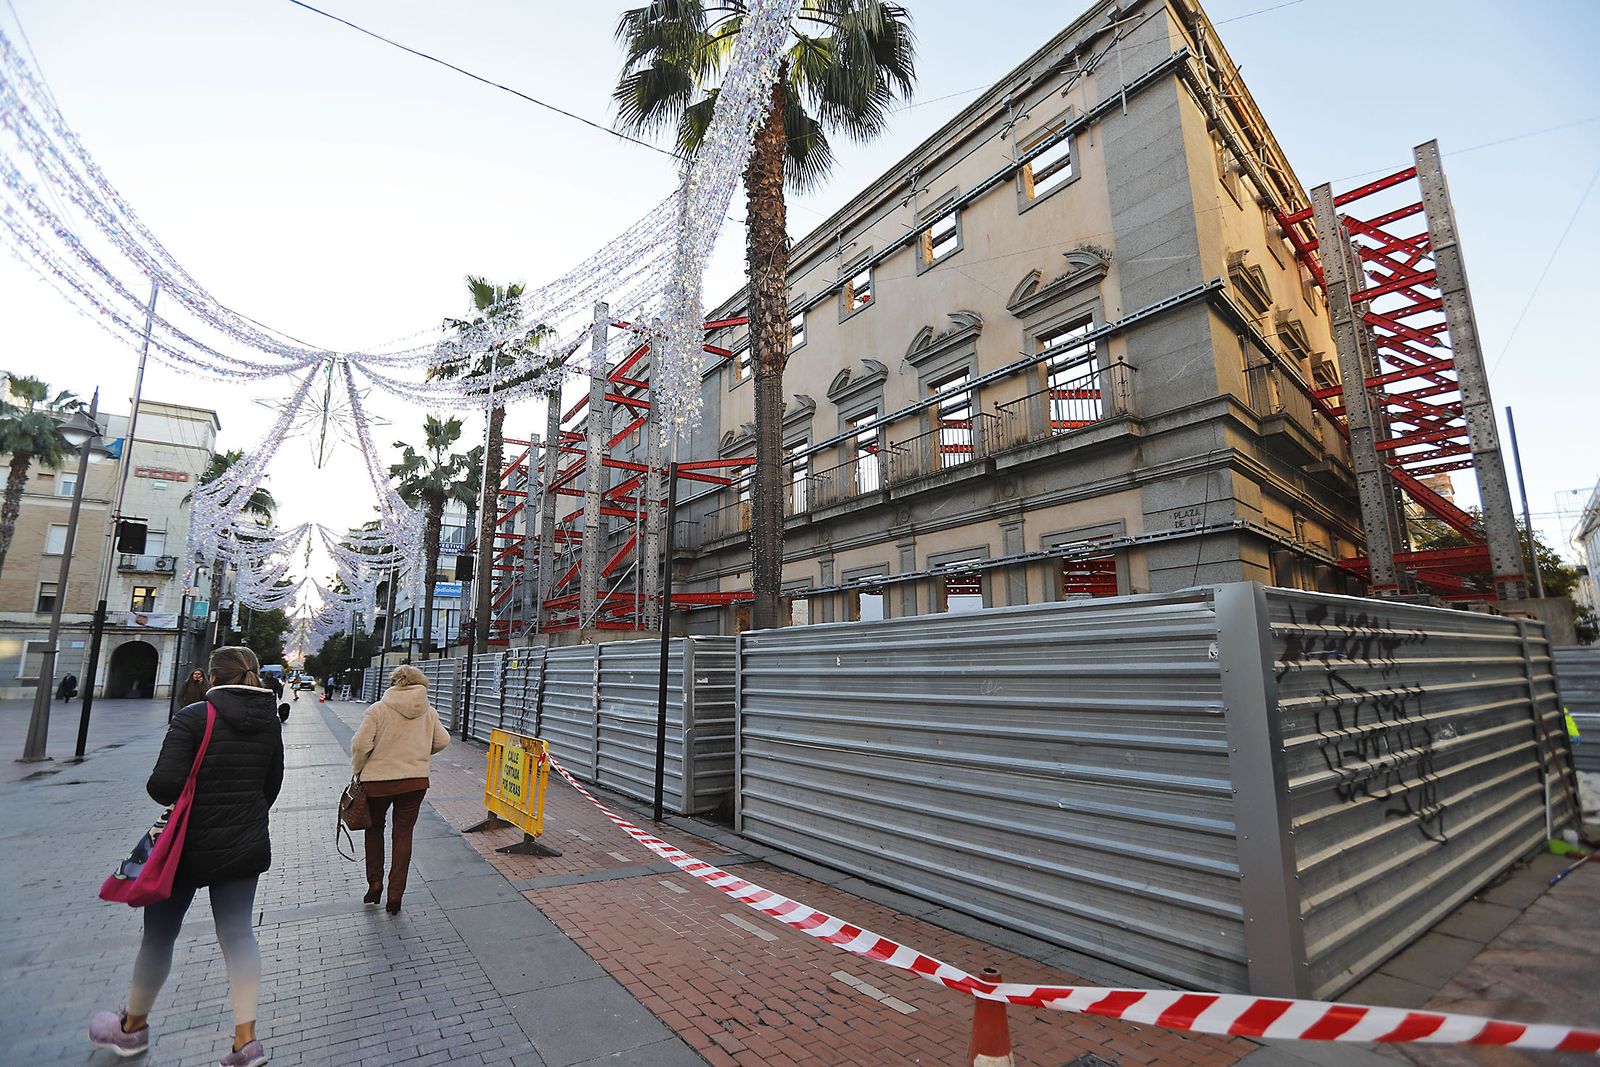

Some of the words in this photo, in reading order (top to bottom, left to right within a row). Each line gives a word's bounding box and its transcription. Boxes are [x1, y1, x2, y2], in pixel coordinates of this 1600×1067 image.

[1173, 509, 1201, 519] PLAZA
[1174, 520, 1186, 528] DE
[1190, 518, 1202, 526] LA
